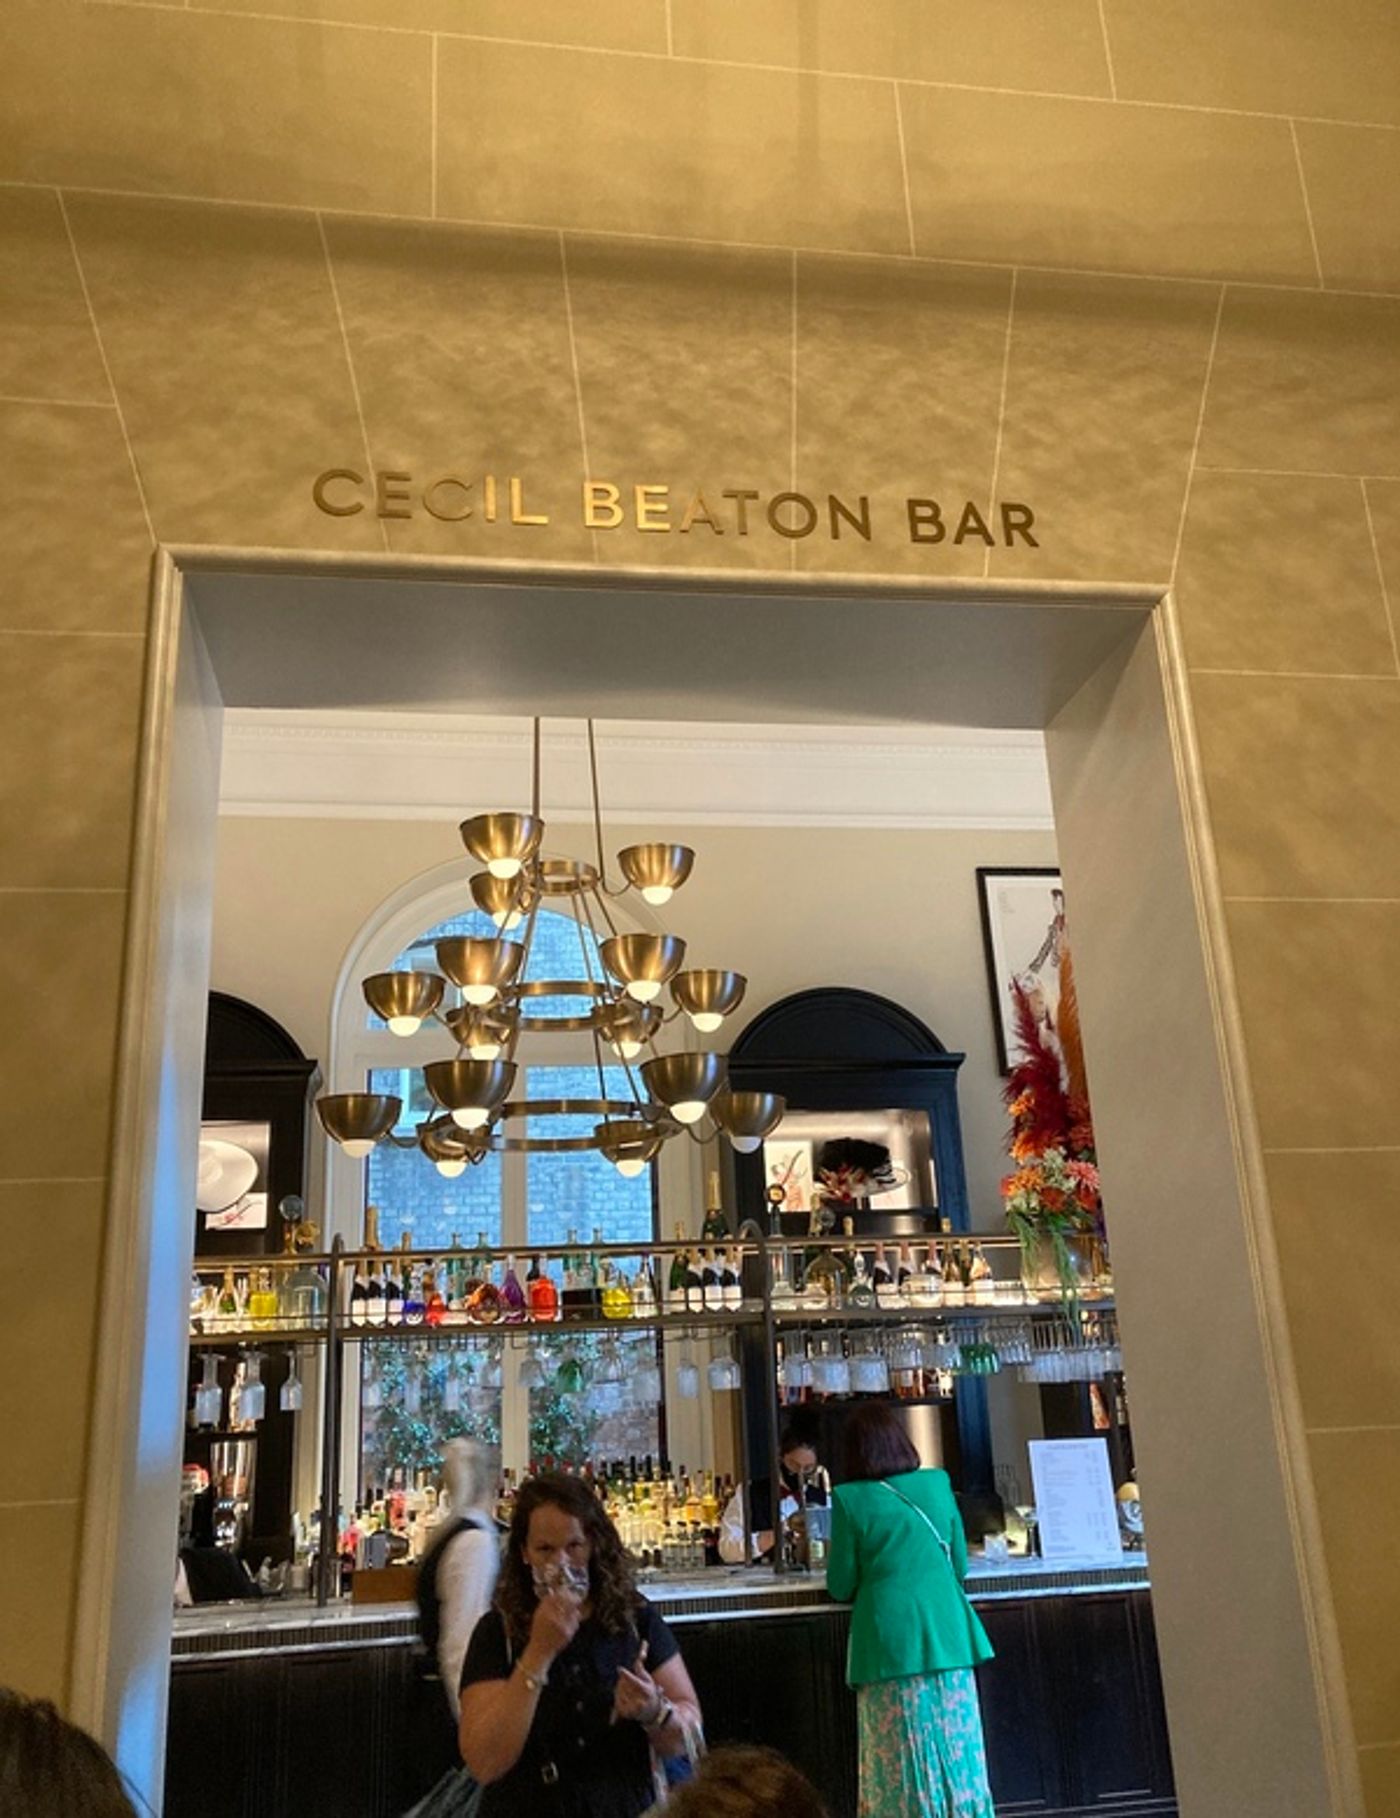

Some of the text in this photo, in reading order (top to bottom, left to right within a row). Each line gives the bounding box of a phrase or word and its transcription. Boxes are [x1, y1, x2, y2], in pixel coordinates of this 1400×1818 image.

[312, 468, 1040, 548] CECIL BEATON BAR
